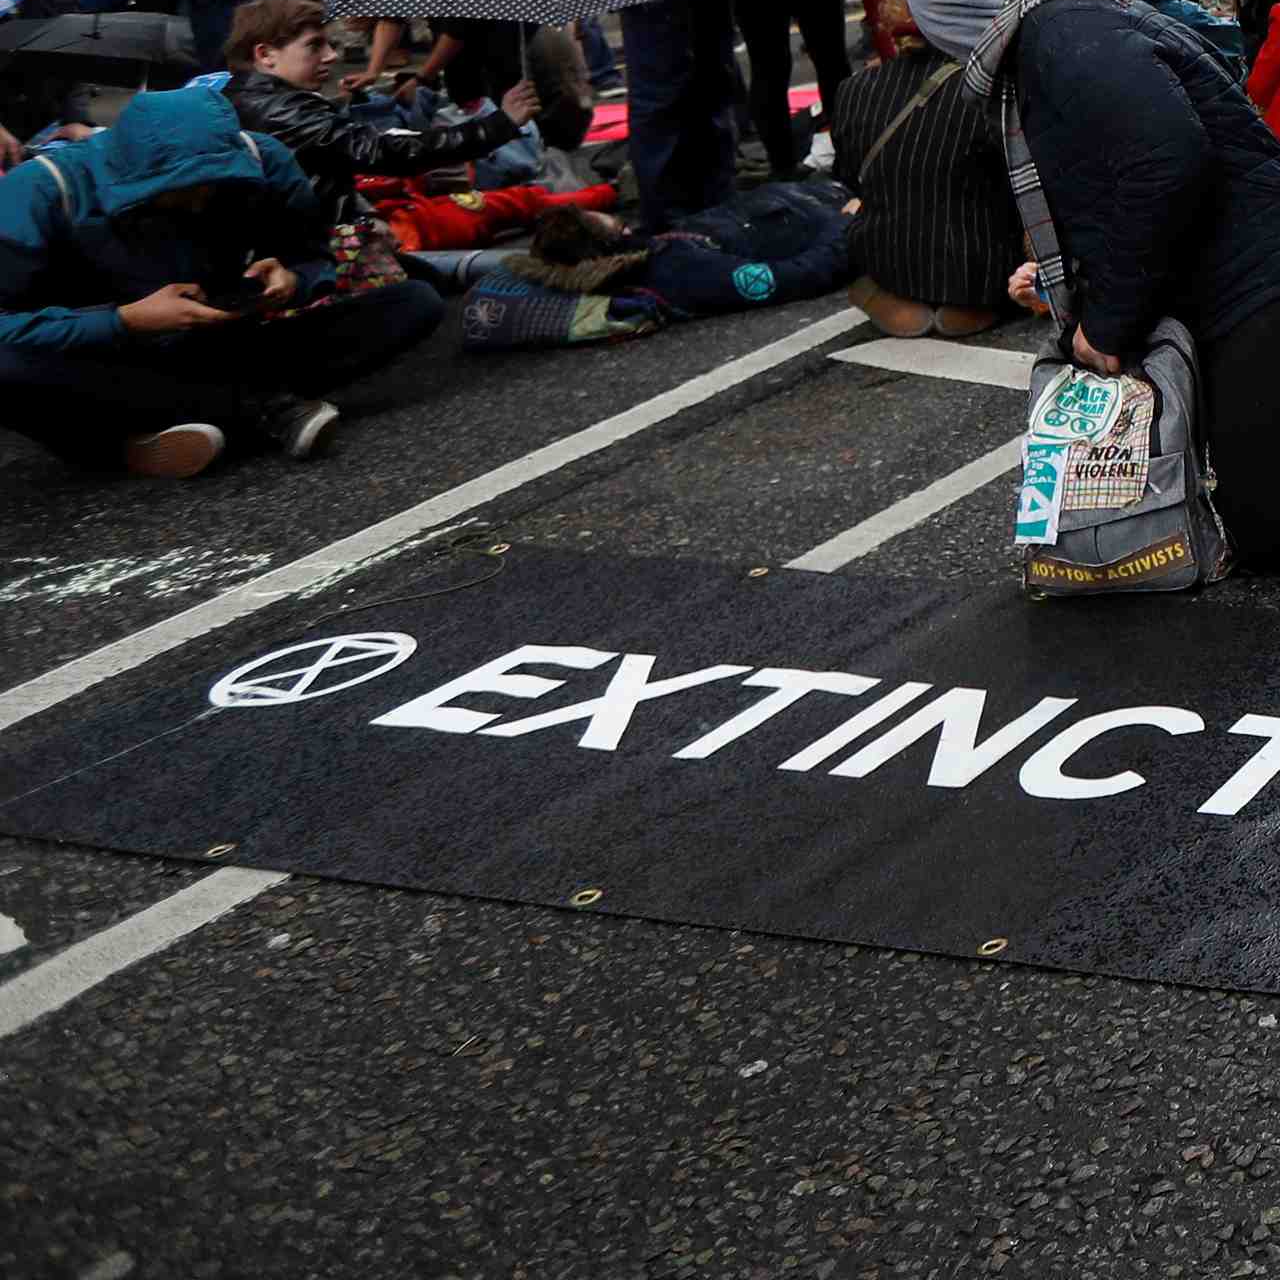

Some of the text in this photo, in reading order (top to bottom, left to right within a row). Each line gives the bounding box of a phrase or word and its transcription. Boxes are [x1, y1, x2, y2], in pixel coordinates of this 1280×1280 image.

[1087, 444, 1133, 462] NON
[1075, 461, 1139, 480] VIOLENT
[1106, 541, 1186, 580] ACTIVISTS
